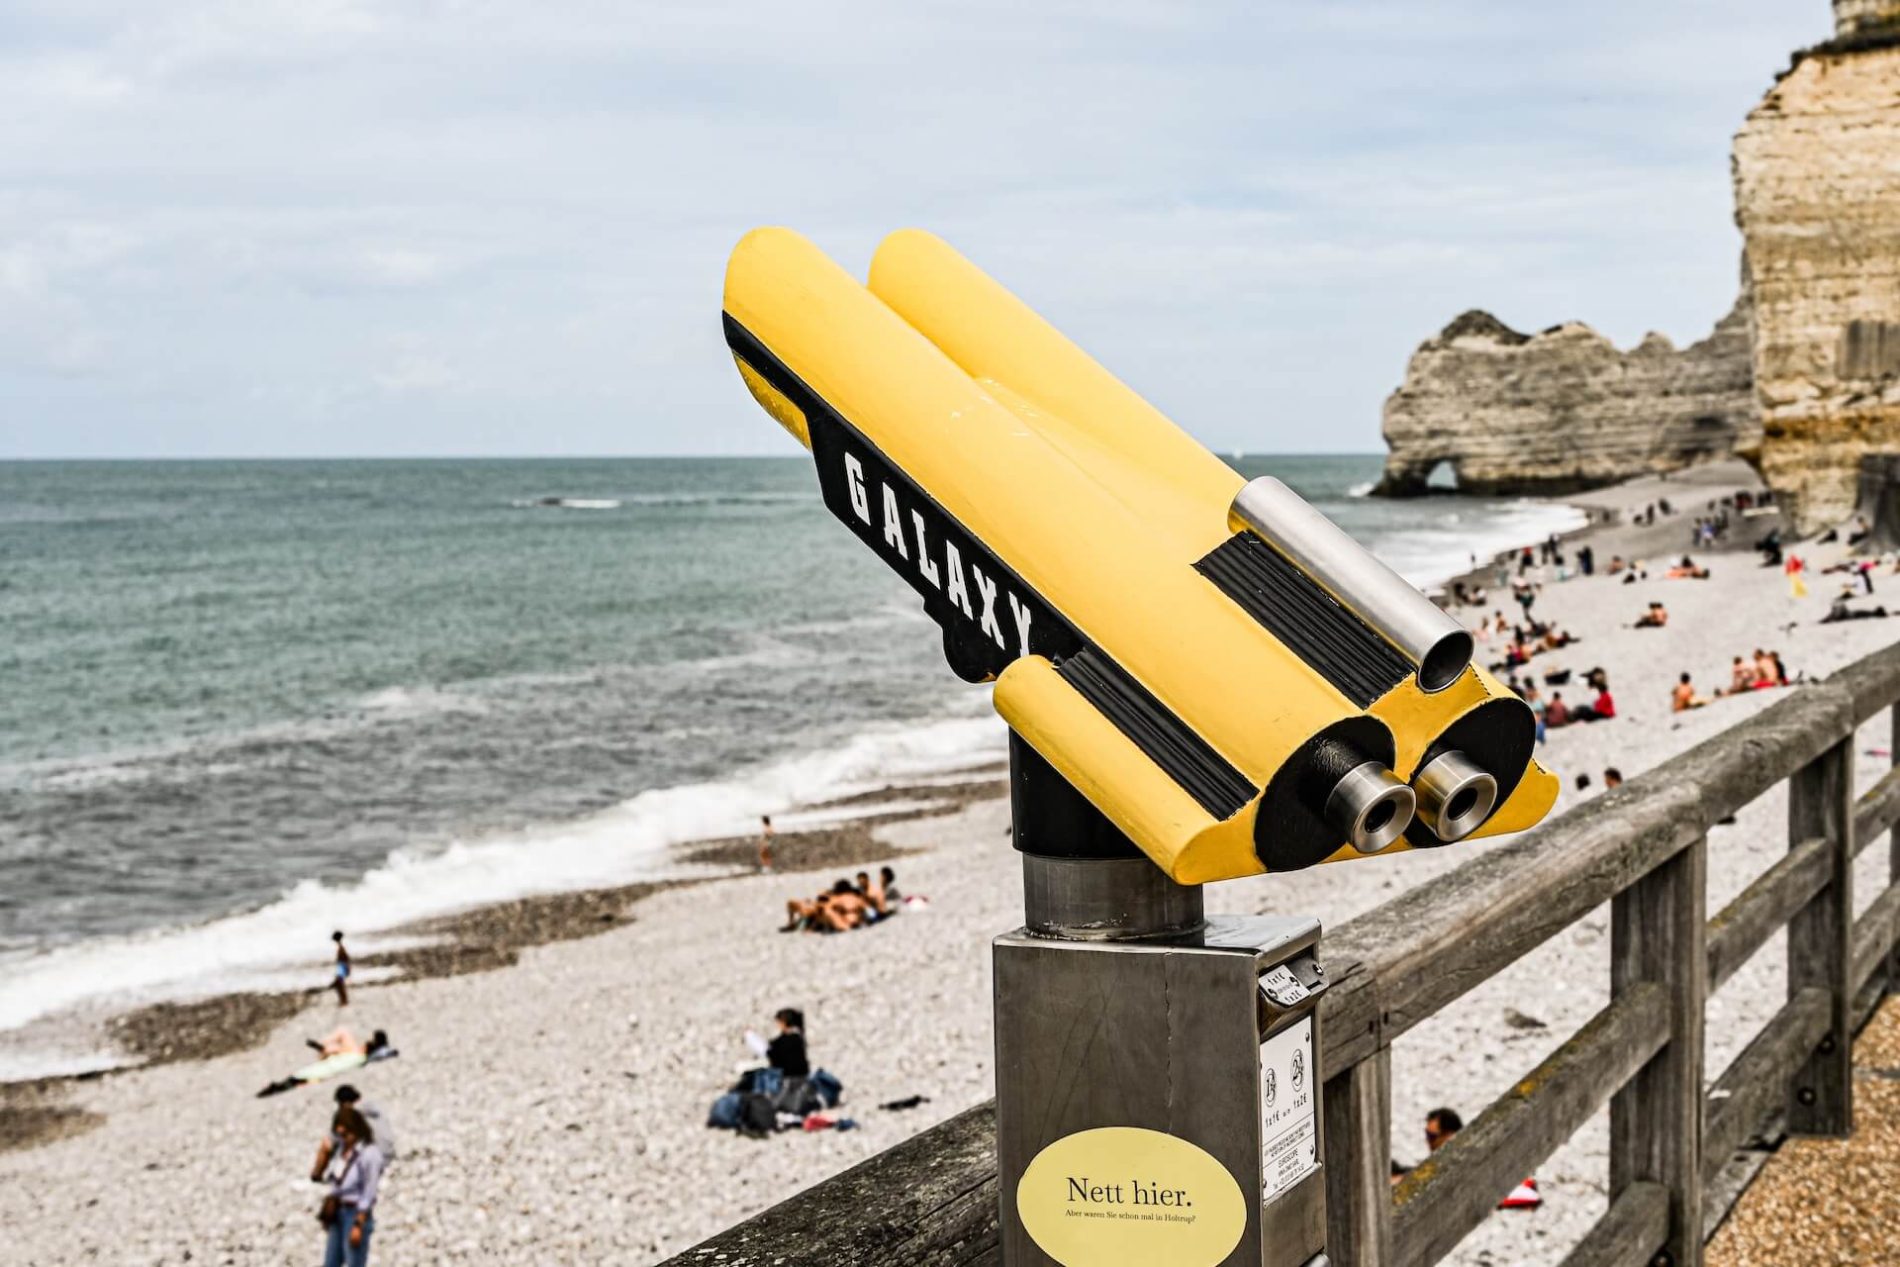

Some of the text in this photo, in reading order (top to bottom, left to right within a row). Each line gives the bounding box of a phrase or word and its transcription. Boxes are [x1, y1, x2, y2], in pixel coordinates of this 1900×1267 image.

[844, 451, 1032, 657] GALAXY
[1066, 1177, 1192, 1207] Nett hier.
[1065, 1209, 1082, 1217] Aber
[1106, 1211, 1117, 1219] Sie
[1118, 1212, 1139, 1220] schon
[1155, 1213, 1163, 1221] in
